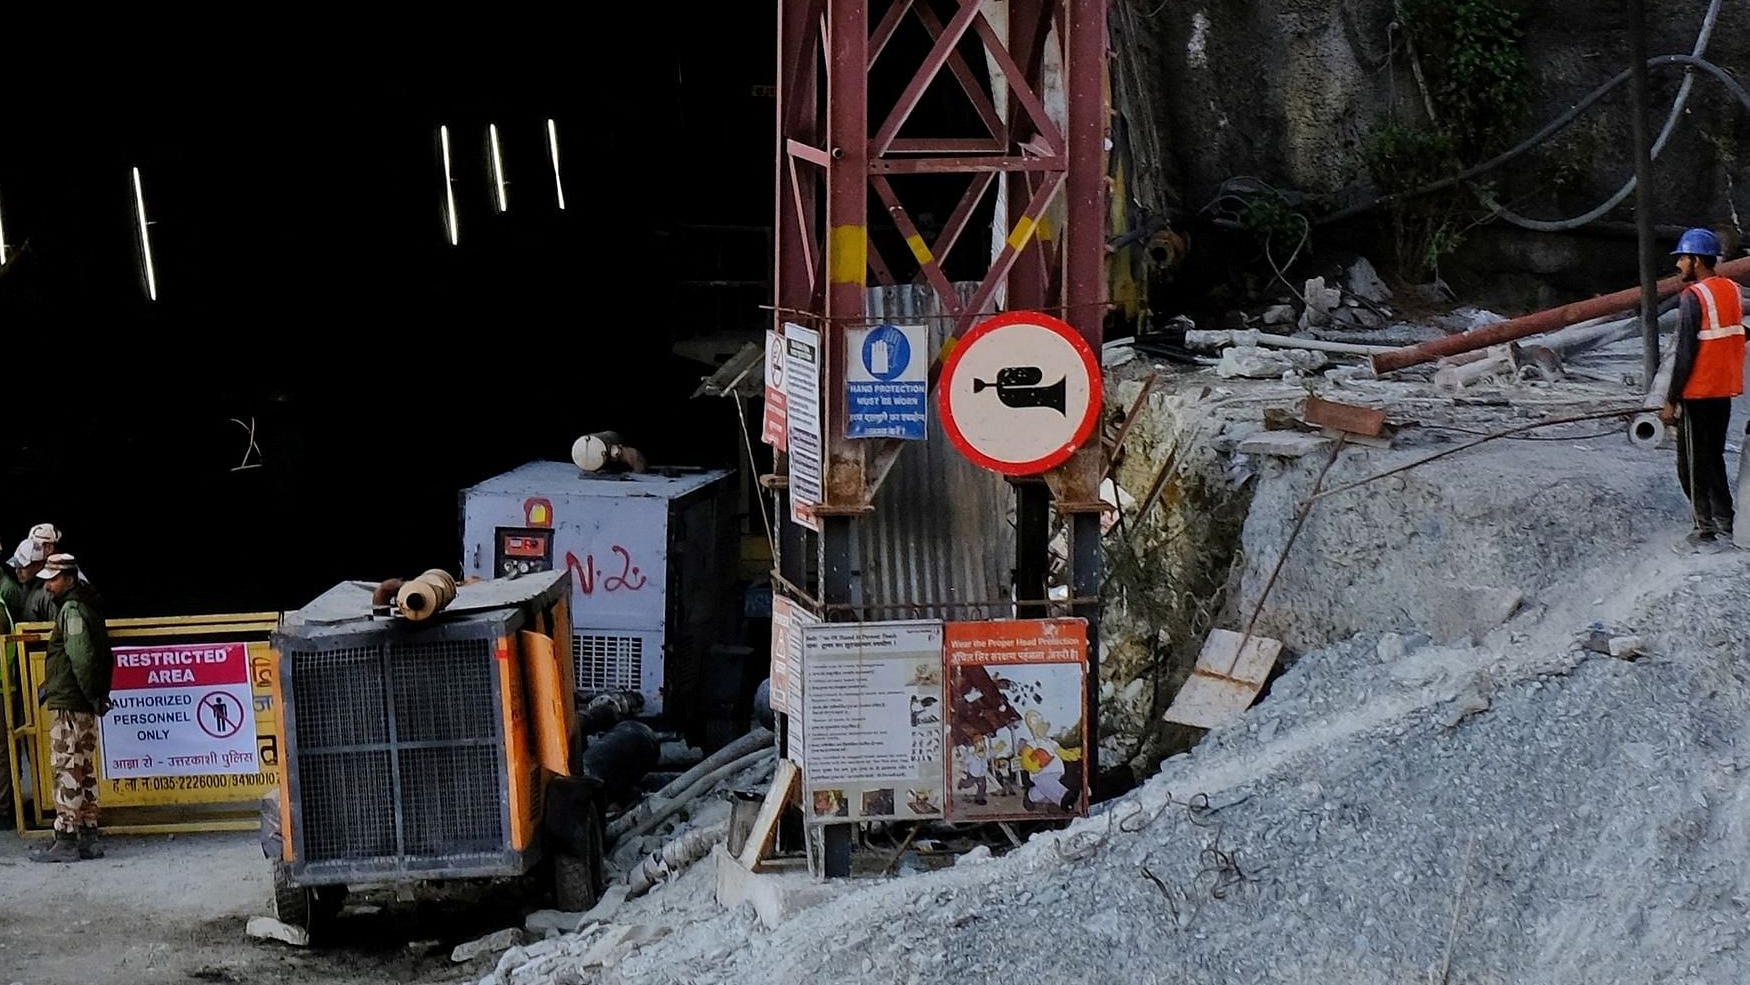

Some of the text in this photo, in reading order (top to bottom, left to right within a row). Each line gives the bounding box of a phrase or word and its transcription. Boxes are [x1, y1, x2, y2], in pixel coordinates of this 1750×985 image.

[850, 384, 925, 393] HAND PROTECTION
[857, 397, 878, 406] MUST
[951, 636, 1079, 648] Wear the Proper Head Protection
[117, 649, 227, 667] RESTRICTED
[148, 669, 195, 684] AREA
[111, 694, 192, 709] AUTHORIZED
[113, 711, 191, 725] PERSONNEL
[137, 730, 170, 741] ONLY
[168, 751, 218, 767] उत्तरकाशी
[222, 750, 254, 768] पुलिस
